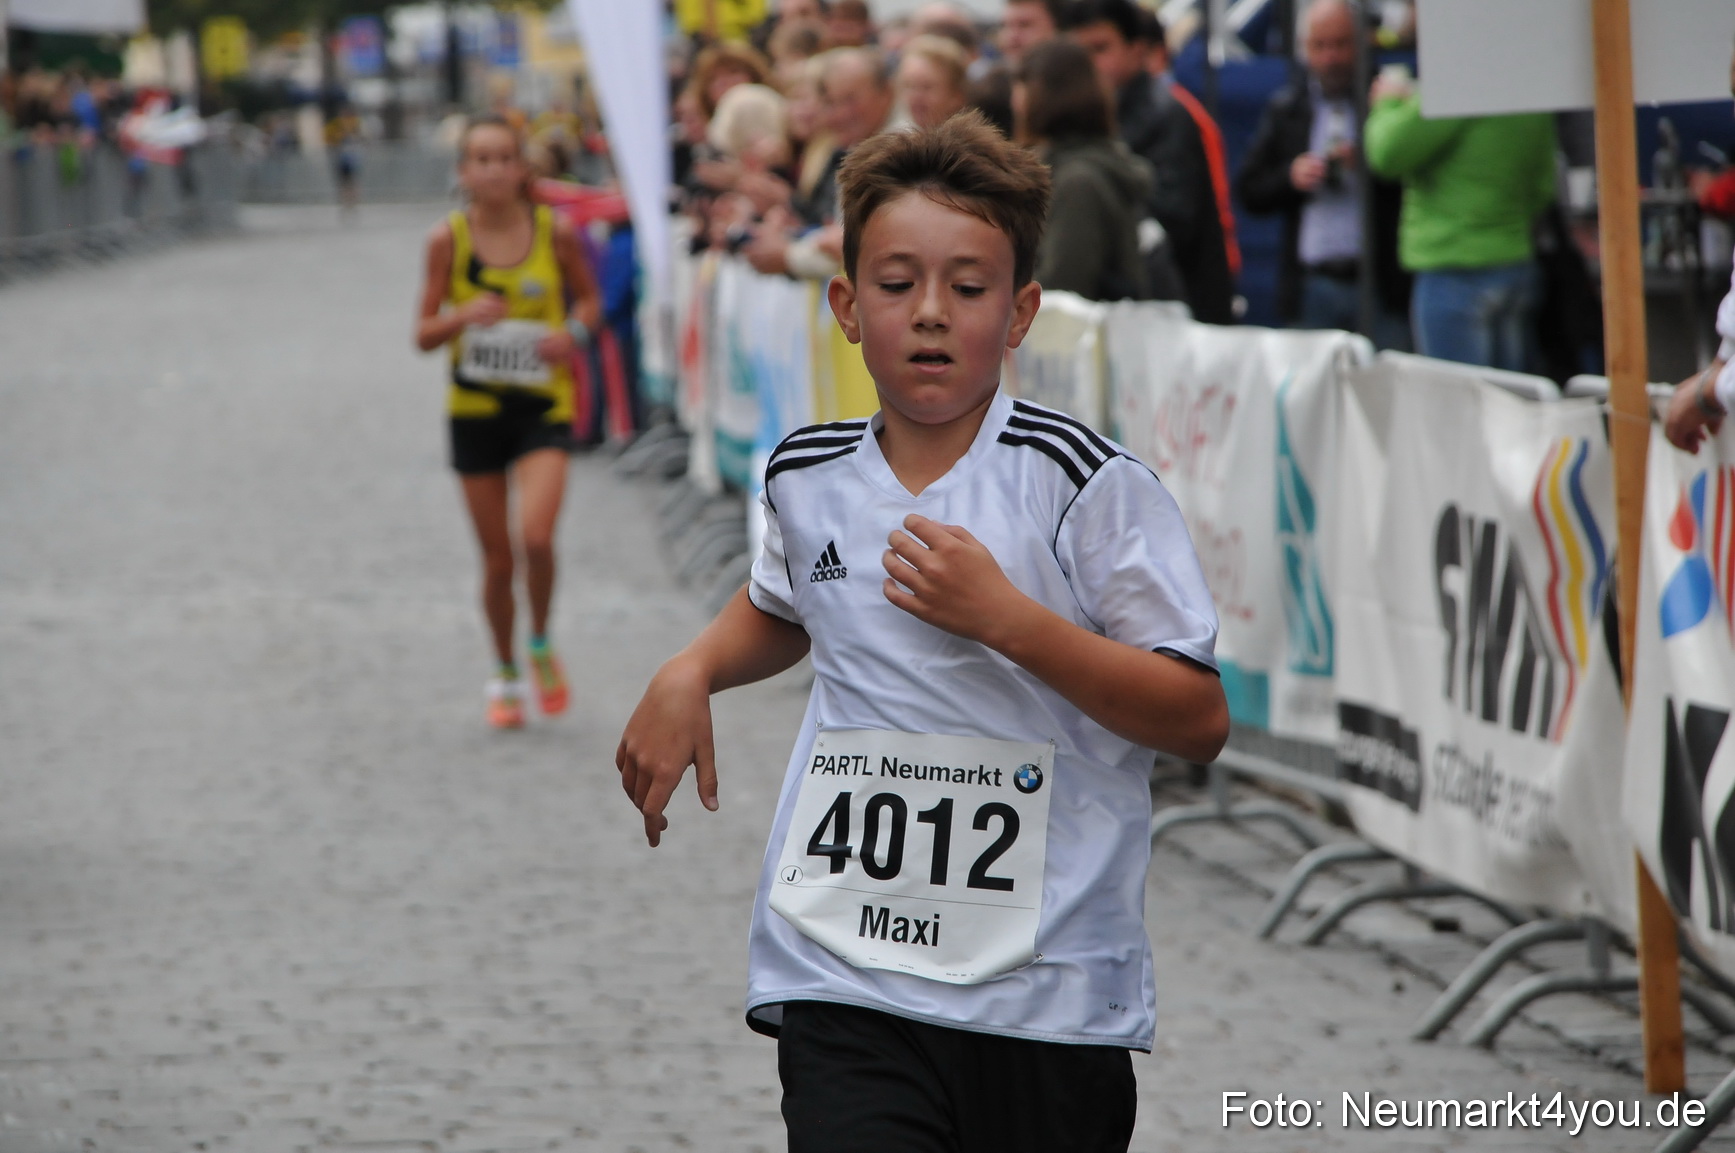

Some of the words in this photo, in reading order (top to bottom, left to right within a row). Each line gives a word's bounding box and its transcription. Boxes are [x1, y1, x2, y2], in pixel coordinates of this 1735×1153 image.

[811, 755, 873, 776] PARTL
[880, 757, 1002, 787] Neumarkt
[806, 791, 1021, 892] 4012
[786, 869, 797, 882] J
[858, 905, 941, 947] Maxi
